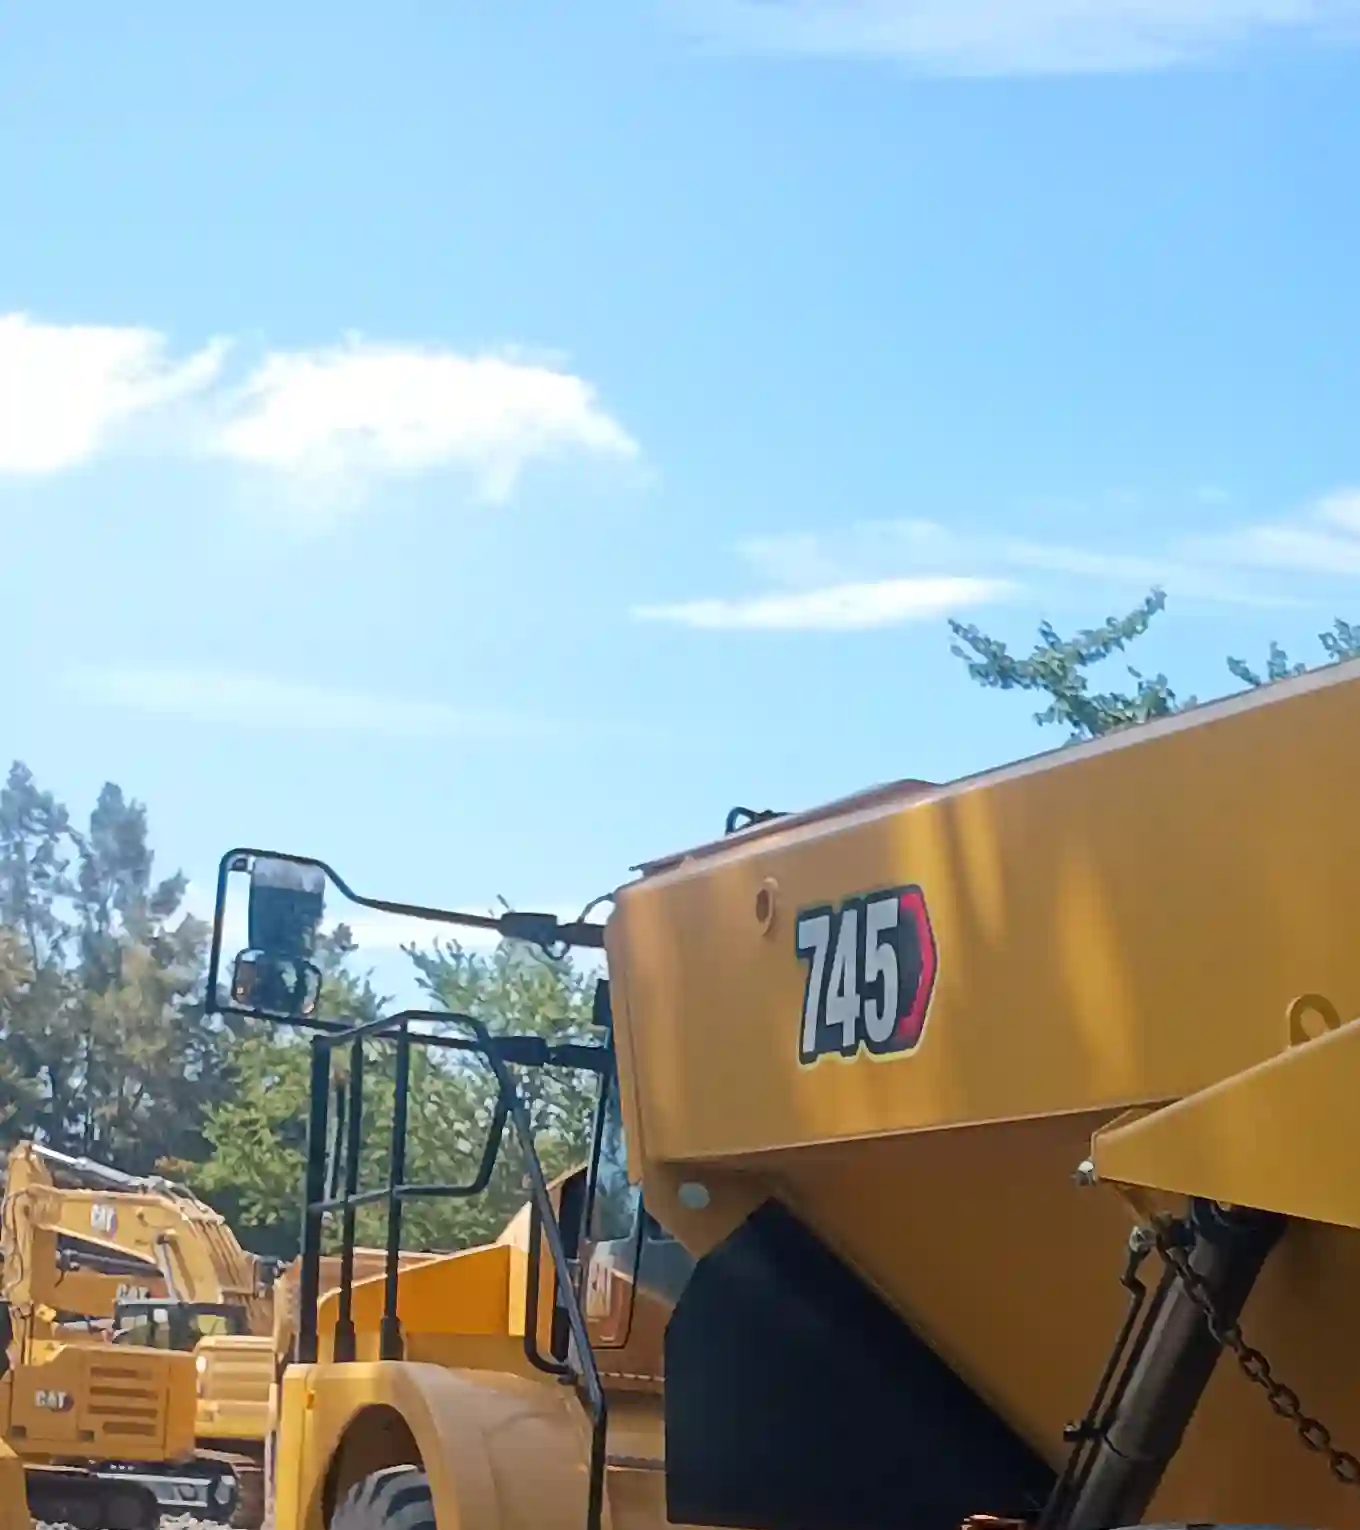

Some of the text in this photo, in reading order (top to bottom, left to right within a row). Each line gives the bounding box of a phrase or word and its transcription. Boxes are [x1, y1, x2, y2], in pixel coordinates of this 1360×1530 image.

[797, 897, 899, 1053] 745
[90, 1203, 116, 1233] CAT
[35, 1389, 67, 1409] CAT
